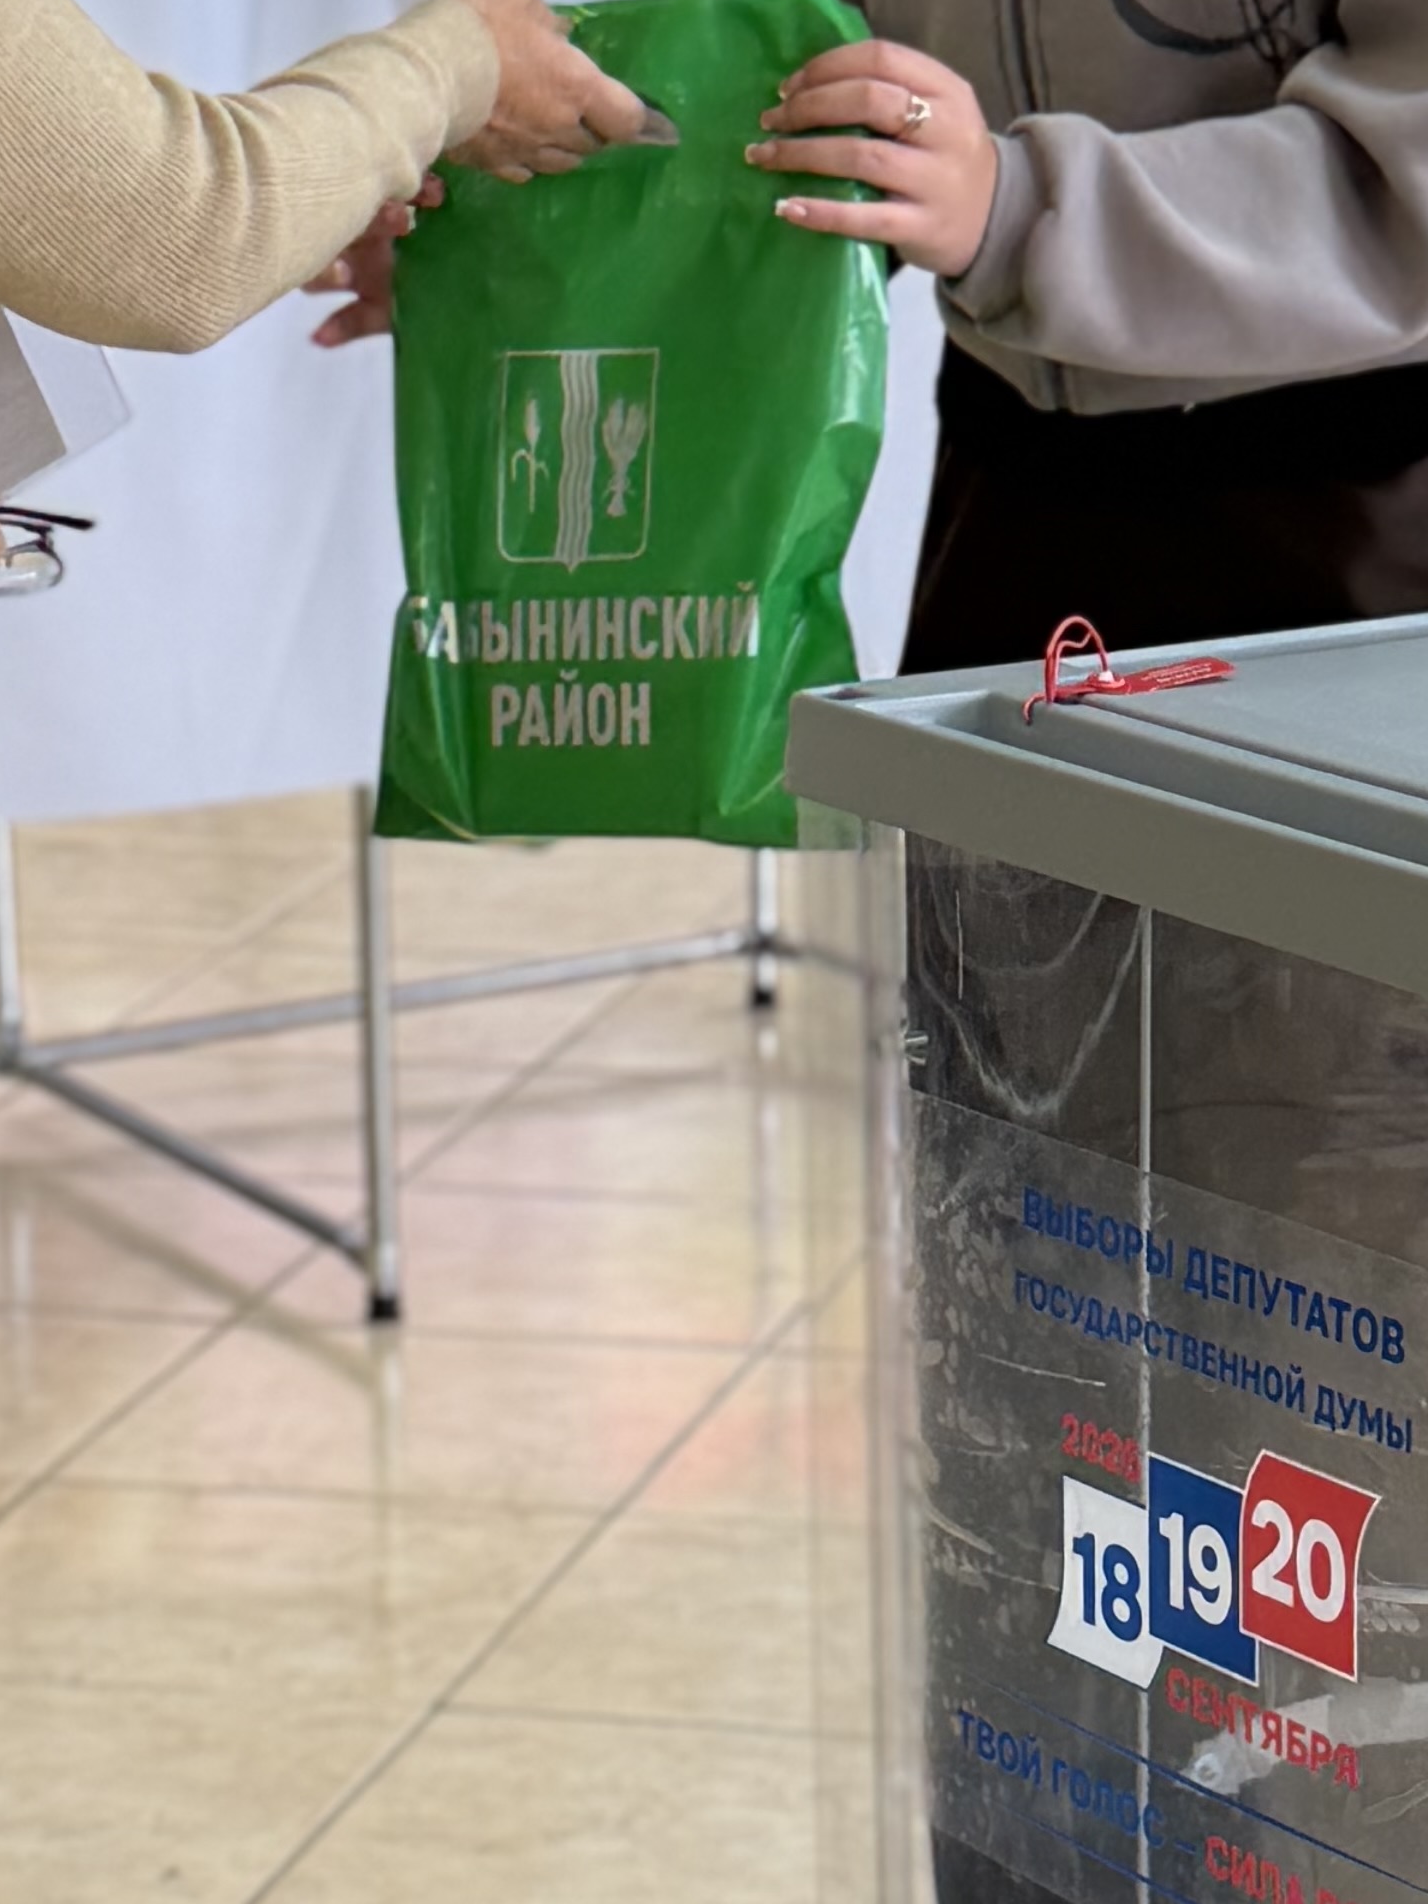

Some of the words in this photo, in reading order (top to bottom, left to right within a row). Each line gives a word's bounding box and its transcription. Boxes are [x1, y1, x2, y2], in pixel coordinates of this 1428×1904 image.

[490, 668, 651, 747] РАЙОН
[1023, 1185, 1175, 1281] ВЫБОРЫ
[1183, 1246, 1406, 1365] ДЕПУТАТОВ
[1013, 1268, 1306, 1414] ГОСУДАРСТВЕННОЙ
[1313, 1383, 1413, 1454] ДУМЫ
[1071, 1531, 1143, 1643] 18
[1158, 1511, 1233, 1626] 19
[1250, 1498, 1347, 1623] 20
[956, 1707, 1043, 1789] ТВОЙ
[1050, 1756, 1165, 1848] ГОЛОС
[1164, 1667, 1362, 1791] СЕНТЯБРЯ
